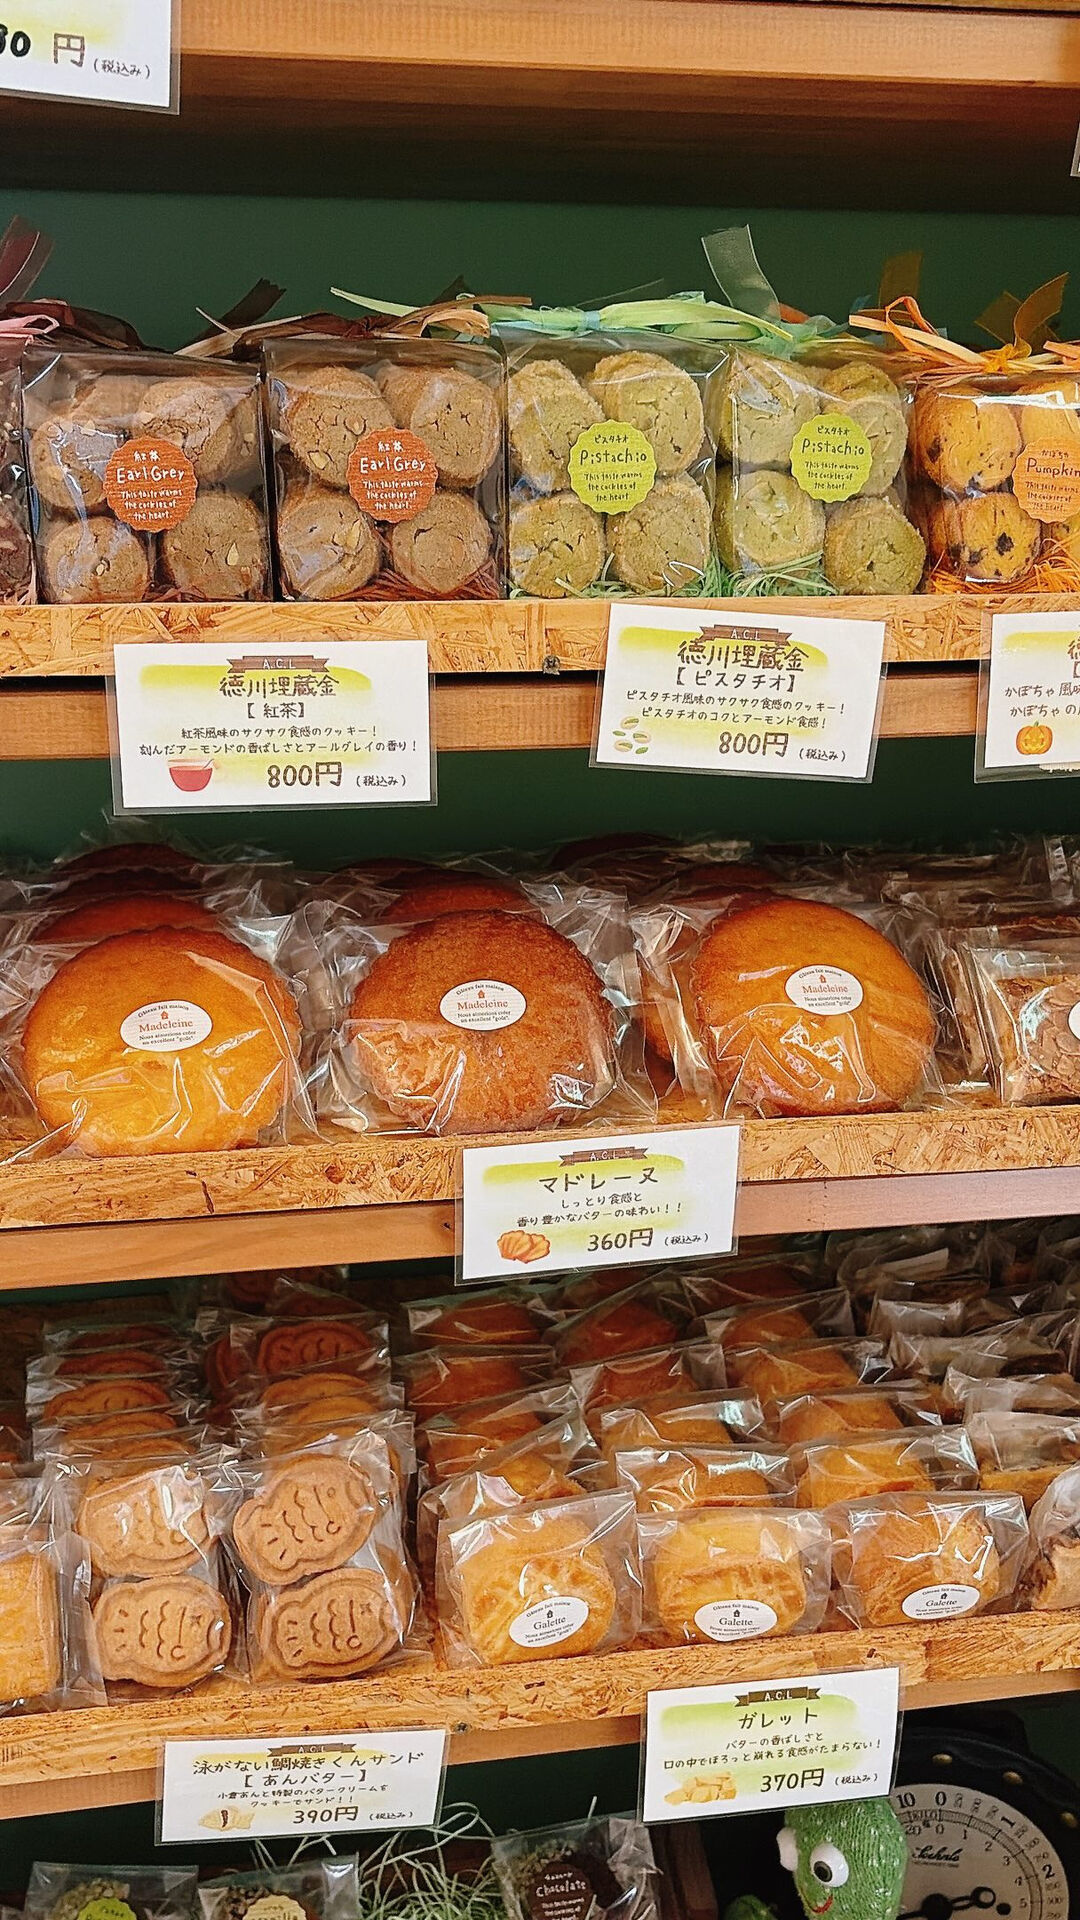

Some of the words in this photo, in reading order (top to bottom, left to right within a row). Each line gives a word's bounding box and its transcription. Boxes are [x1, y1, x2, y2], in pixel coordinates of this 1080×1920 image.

[94, 58, 150, 79] (税込み)
[580, 448, 647, 465] Pistachio
[802, 438, 865, 456] Pistachio
[116, 466, 147, 484] Earl
[151, 465, 184, 481] Grey
[360, 457, 390, 474] Earl
[393, 456, 426, 472] Grey
[1026, 457, 1080, 478] Pumpkin
[677, 640, 809, 673] 徳川埋蔵金
[219, 674, 340, 698] 徳川埋蔵金
[676, 666, 796, 693] 【ピスタチオ】
[626, 690, 845, 715] ピスタチオ風味のサクサク食感のクッキー！
[642, 706, 827, 729] ピスタチオのコクとアーモンド食感！
[181, 725, 377, 740] 紅茶風味のサクサク食感のクッキー！
[718, 731, 789, 758] 800円
[798, 748, 846, 763] (税込み)
[267, 761, 342, 789] 800円
[355, 774, 407, 788] (税込み)
[802, 984, 849, 994] Madeleine
[457, 1000, 509, 1011] Madeleine
[139, 1019, 194, 1033] Madeleine
[539, 1167, 659, 1194] マドレーヌ
[561, 1192, 643, 1210] しっとり食感と
[517, 1202, 682, 1228] 香り豊かなバターの味わい！！
[587, 1227, 653, 1252] 360円
[664, 1232, 709, 1246] (税込み)
[533, 1617, 566, 1630] Galette
[719, 1617, 753, 1626] Galette
[738, 1707, 818, 1730] ガレット
[726, 1732, 824, 1750] バターの香ばしさと
[193, 1752, 424, 1775] 泳がない鯛焼きくんサンド
[244, 1771, 367, 1788] 【あんバター】
[760, 1768, 825, 1793] 370円
[834, 1775, 878, 1786] (税込み)
[293, 1806, 359, 1824] 390円
[536, 1880, 586, 1897] Chocolate
